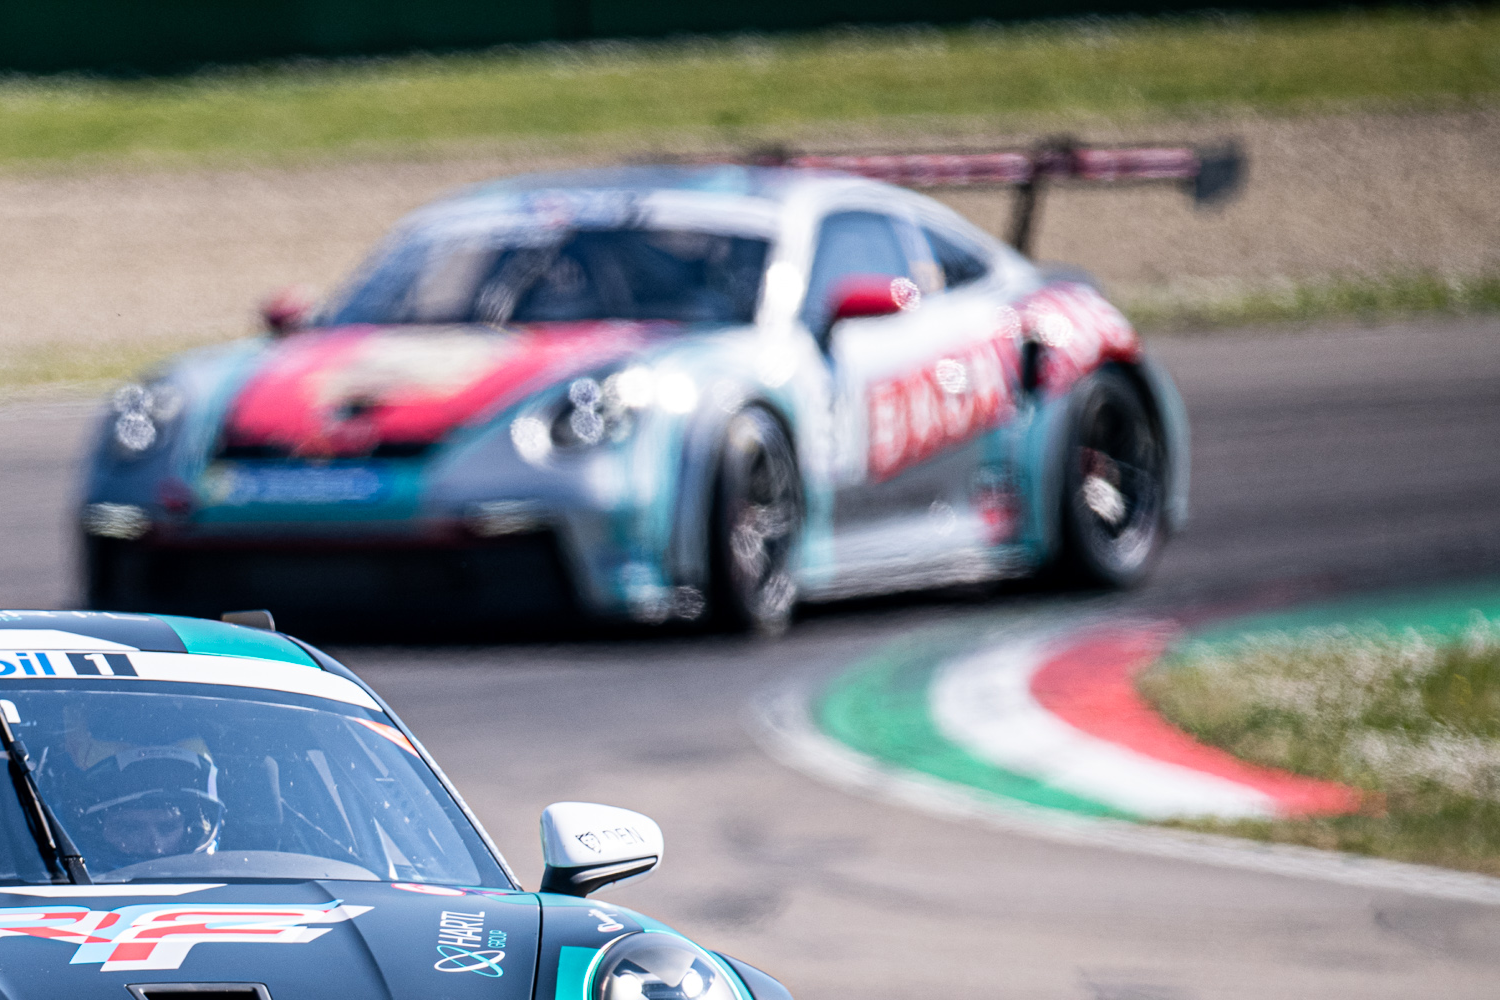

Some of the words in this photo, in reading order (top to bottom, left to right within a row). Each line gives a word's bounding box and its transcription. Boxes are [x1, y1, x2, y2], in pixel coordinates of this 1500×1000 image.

[82, 653, 116, 677] 1
[437, 910, 486, 948] HARTL
[487, 929, 508, 949] GROUP
